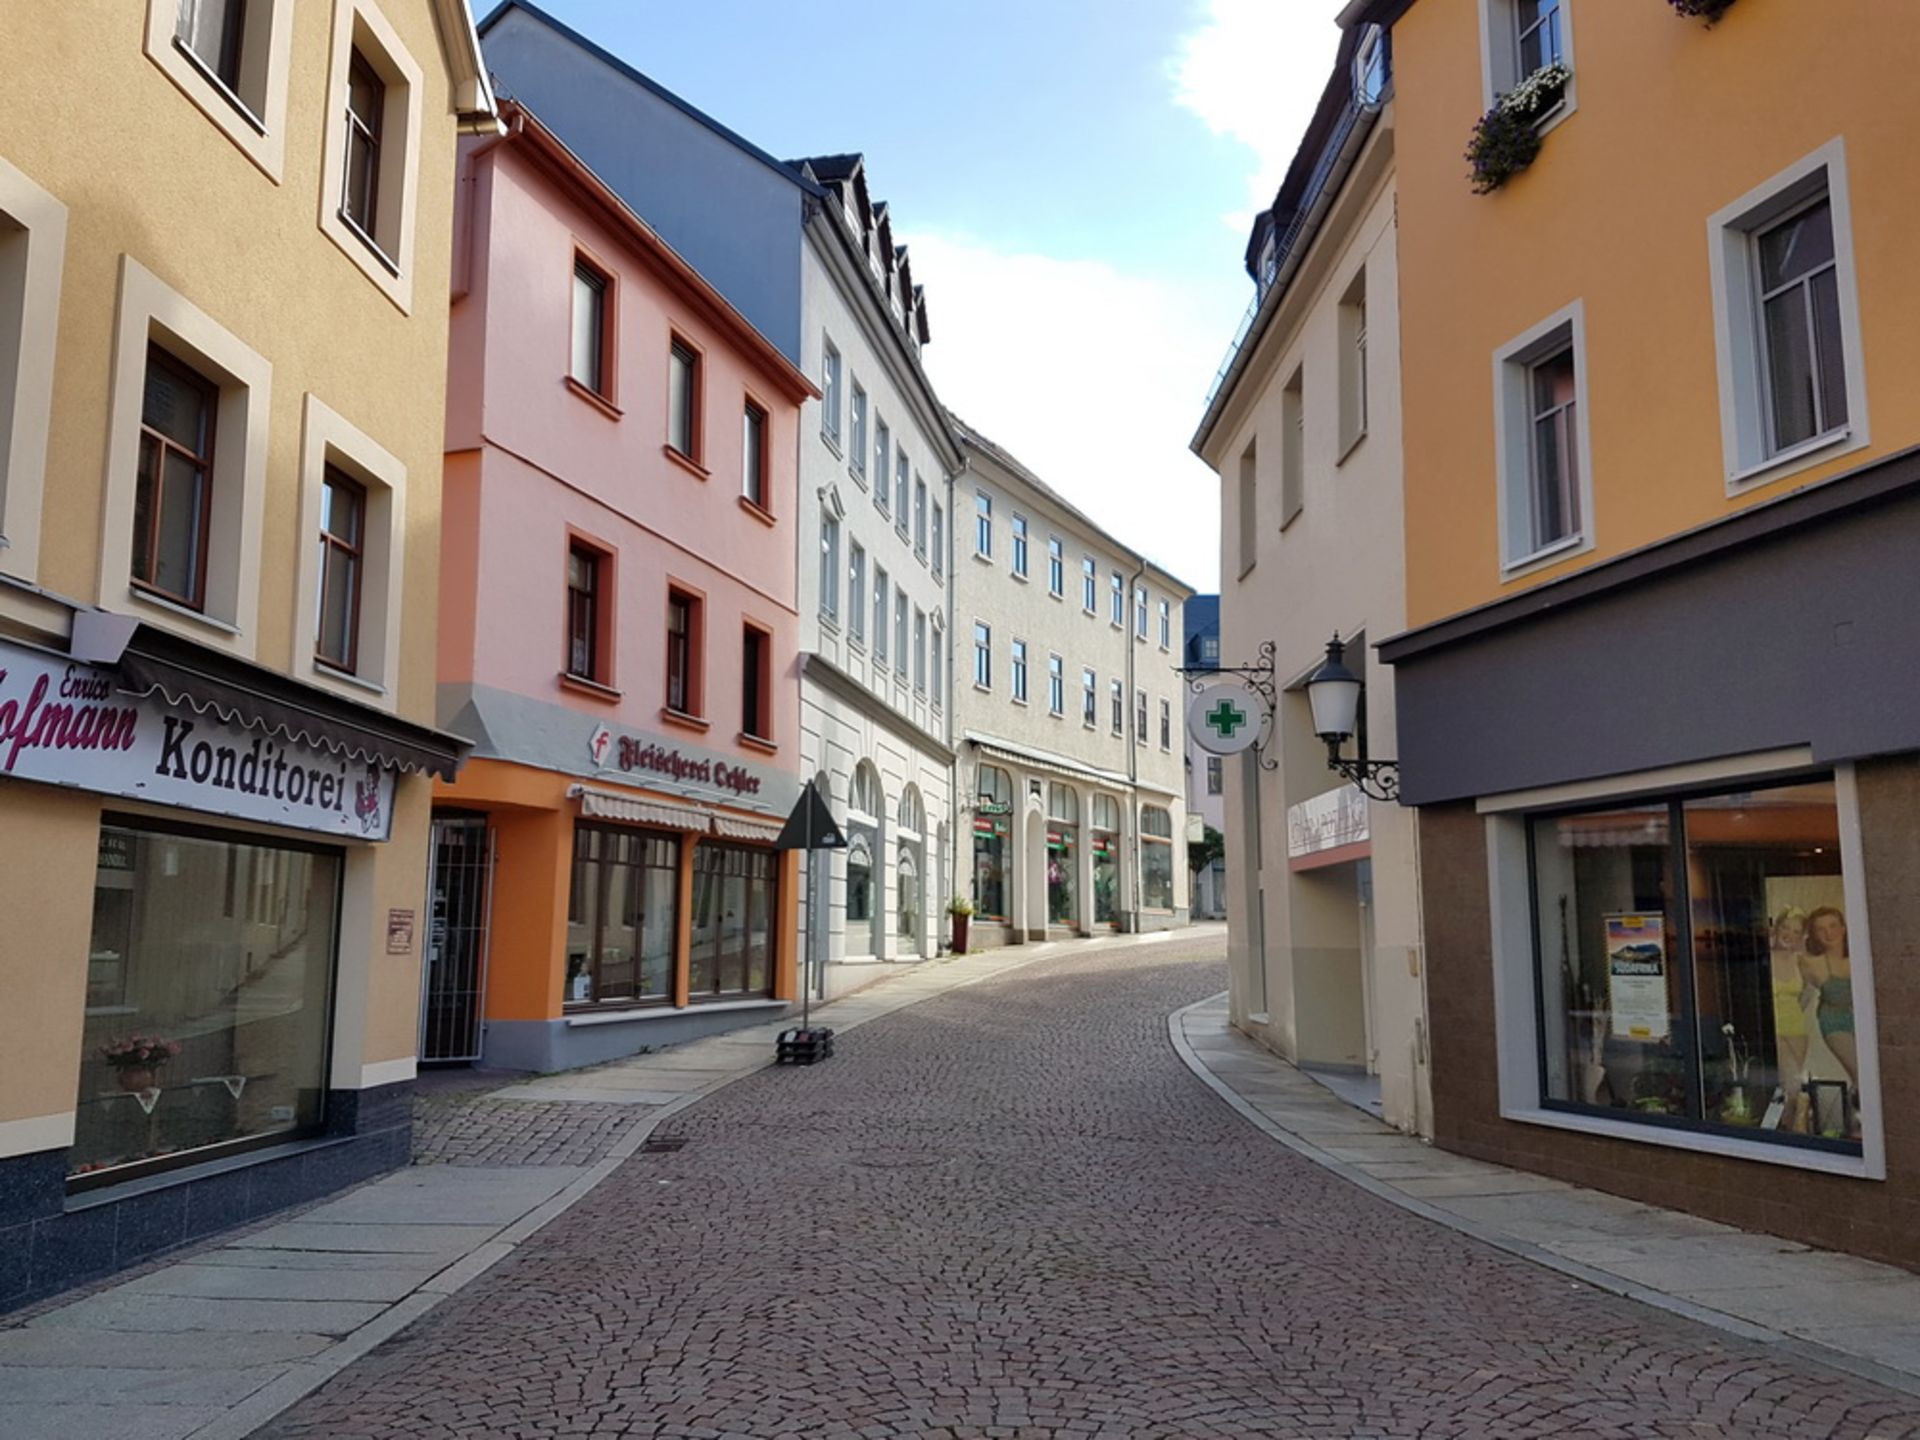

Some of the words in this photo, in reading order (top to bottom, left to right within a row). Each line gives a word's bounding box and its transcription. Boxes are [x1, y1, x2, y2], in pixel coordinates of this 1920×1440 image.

[60, 664, 110, 701] Enrico
[0, 668, 138, 772] ofmann
[155, 716, 346, 811] Konditorei
[618, 735, 711, 782] Fleischerei
